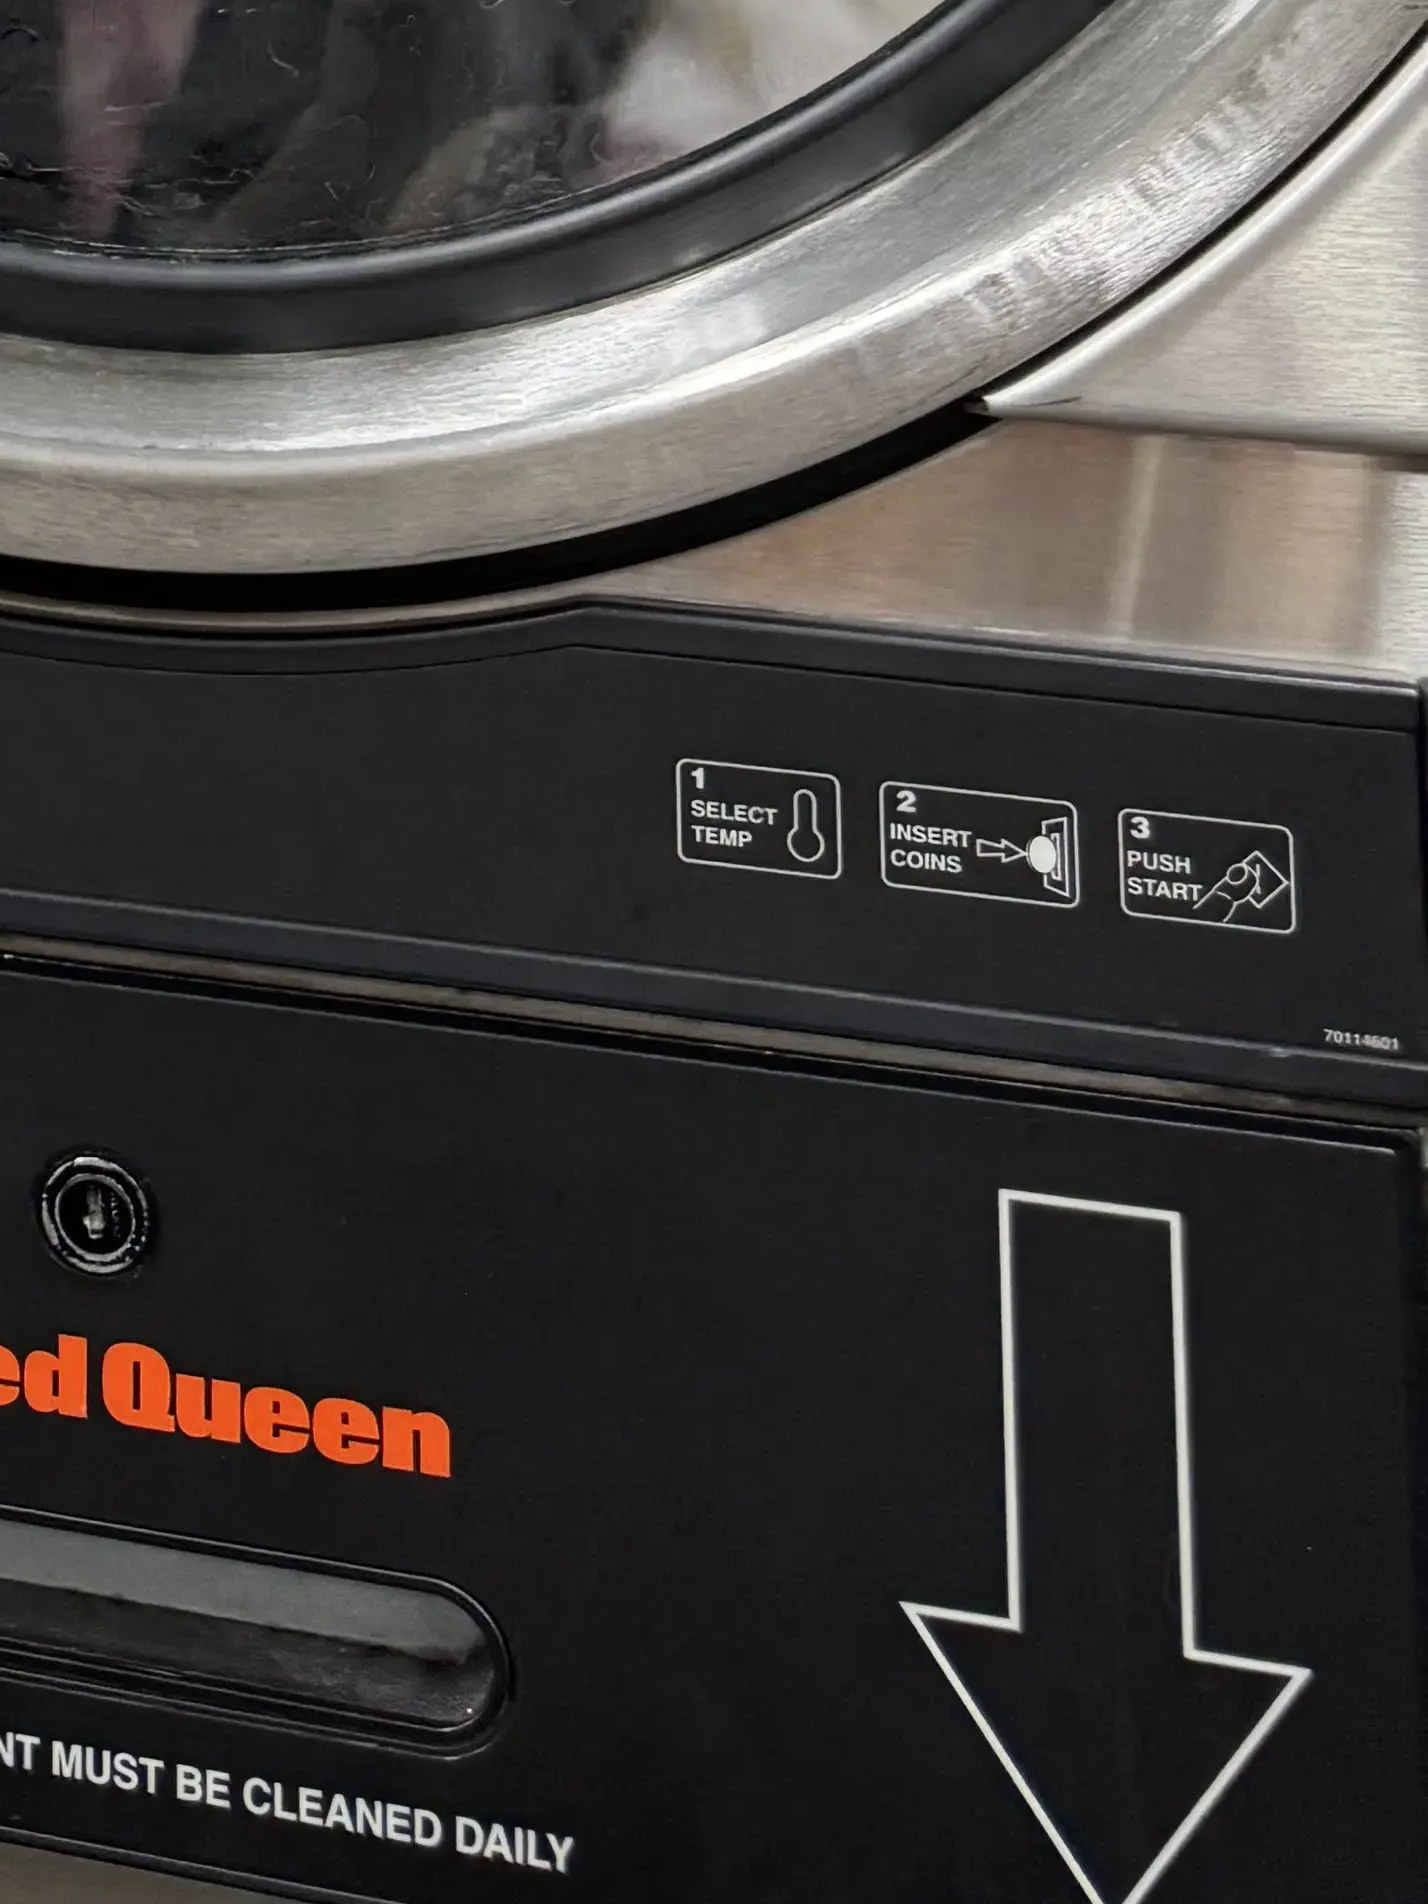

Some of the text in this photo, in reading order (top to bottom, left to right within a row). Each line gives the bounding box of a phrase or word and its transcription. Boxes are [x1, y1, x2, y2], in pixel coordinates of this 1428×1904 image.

[691, 768, 705, 789] 1
[690, 799, 779, 826] SELECT
[896, 790, 916, 814] 2
[691, 824, 753, 849] TEMP
[889, 822, 973, 850] INSERT
[1130, 816, 1151, 840] 3
[890, 848, 964, 875] COINS
[1127, 849, 1192, 876] PUSH
[1127, 877, 1204, 903] START
[101, 1342, 451, 1478] Queen
[50, 1740, 170, 1796] MUST
[176, 1764, 232, 1805] BE
[242, 1777, 444, 1848] CLEANED
[455, 1814, 575, 1876] DAILY
